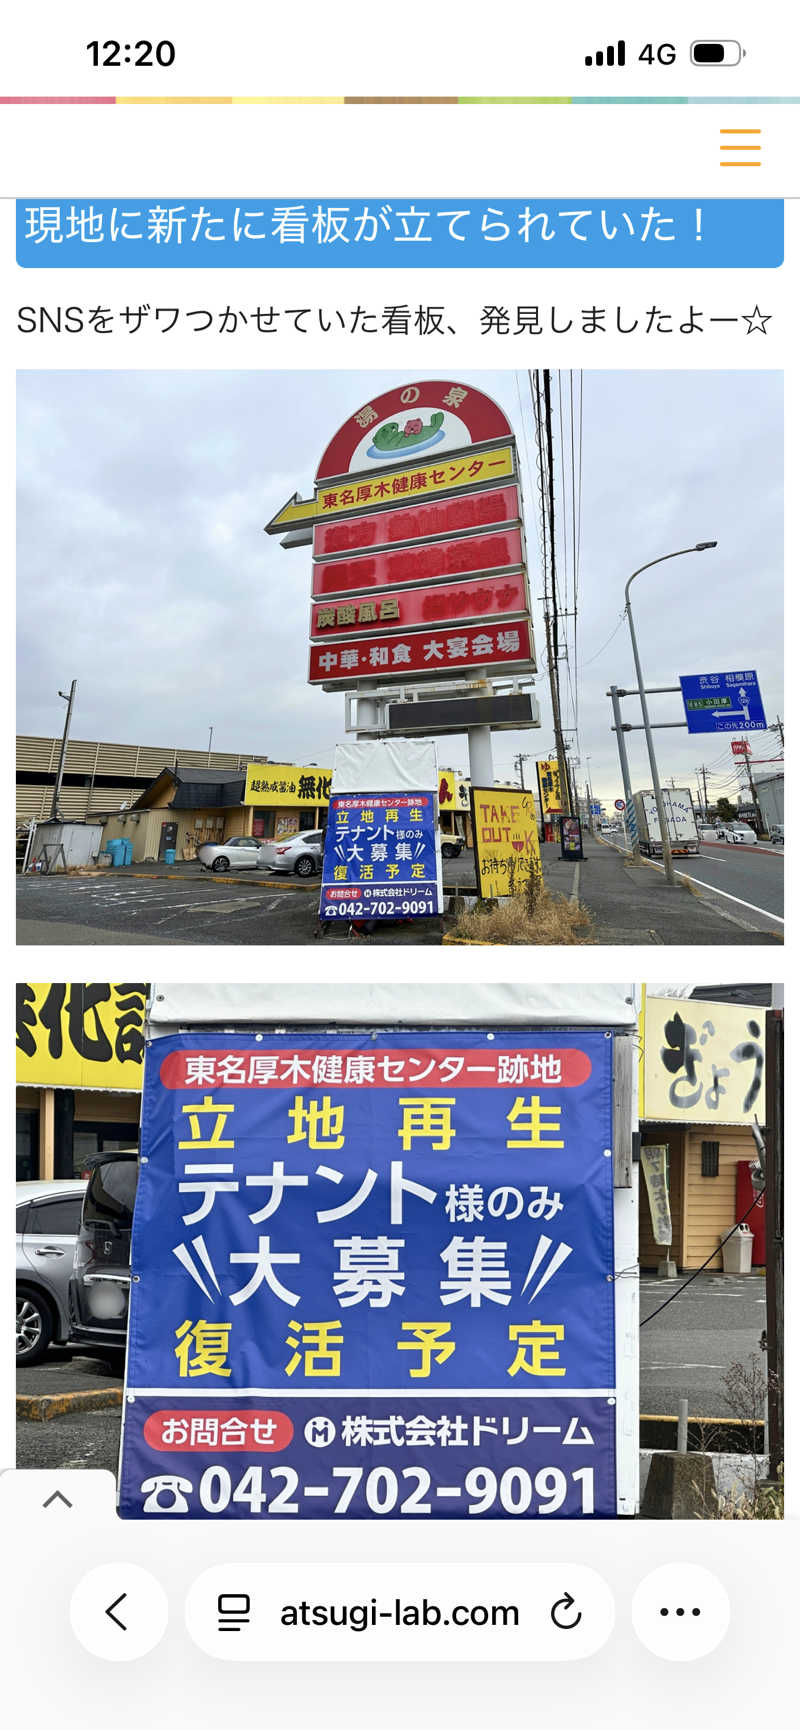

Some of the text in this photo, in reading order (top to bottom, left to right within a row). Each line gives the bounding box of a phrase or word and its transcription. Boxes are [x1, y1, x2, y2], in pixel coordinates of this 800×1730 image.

[86, 39, 677, 67] 12:20 4G
[24, 204, 704, 245] 現地に新たに看板が立てられていた！
[354, 386, 469, 428] 湯の泉
[321, 458, 506, 510] 東名厚木健康センター
[316, 599, 400, 629] 炭酸風呂
[423, 631, 521, 661] 大宴会場
[335, 808, 424, 824] 立地再生
[479, 804, 520, 823] TAKE
[335, 824, 423, 842] テナント様のみ
[481, 827, 511, 843] OUT
[333, 863, 426, 881] 復活予定
[338, 900, 434, 916] 042-702-9091
[372, 888, 433, 897] 株式会社ドリーム
[184, 1053, 562, 1087] 東名厚木健康センター跡地
[178, 1096, 565, 1150] 立地再生
[178, 1160, 565, 1226] テナント様のみ
[174, 1319, 567, 1378] 復活予定
[161, 1417, 278, 1447] お問合せ
[341, 1415, 595, 1448] 株式会社ドリーム
[199, 1465, 595, 1516] 042-702-9091
[280, 1598, 520, 1632] atsugi-lab.com
